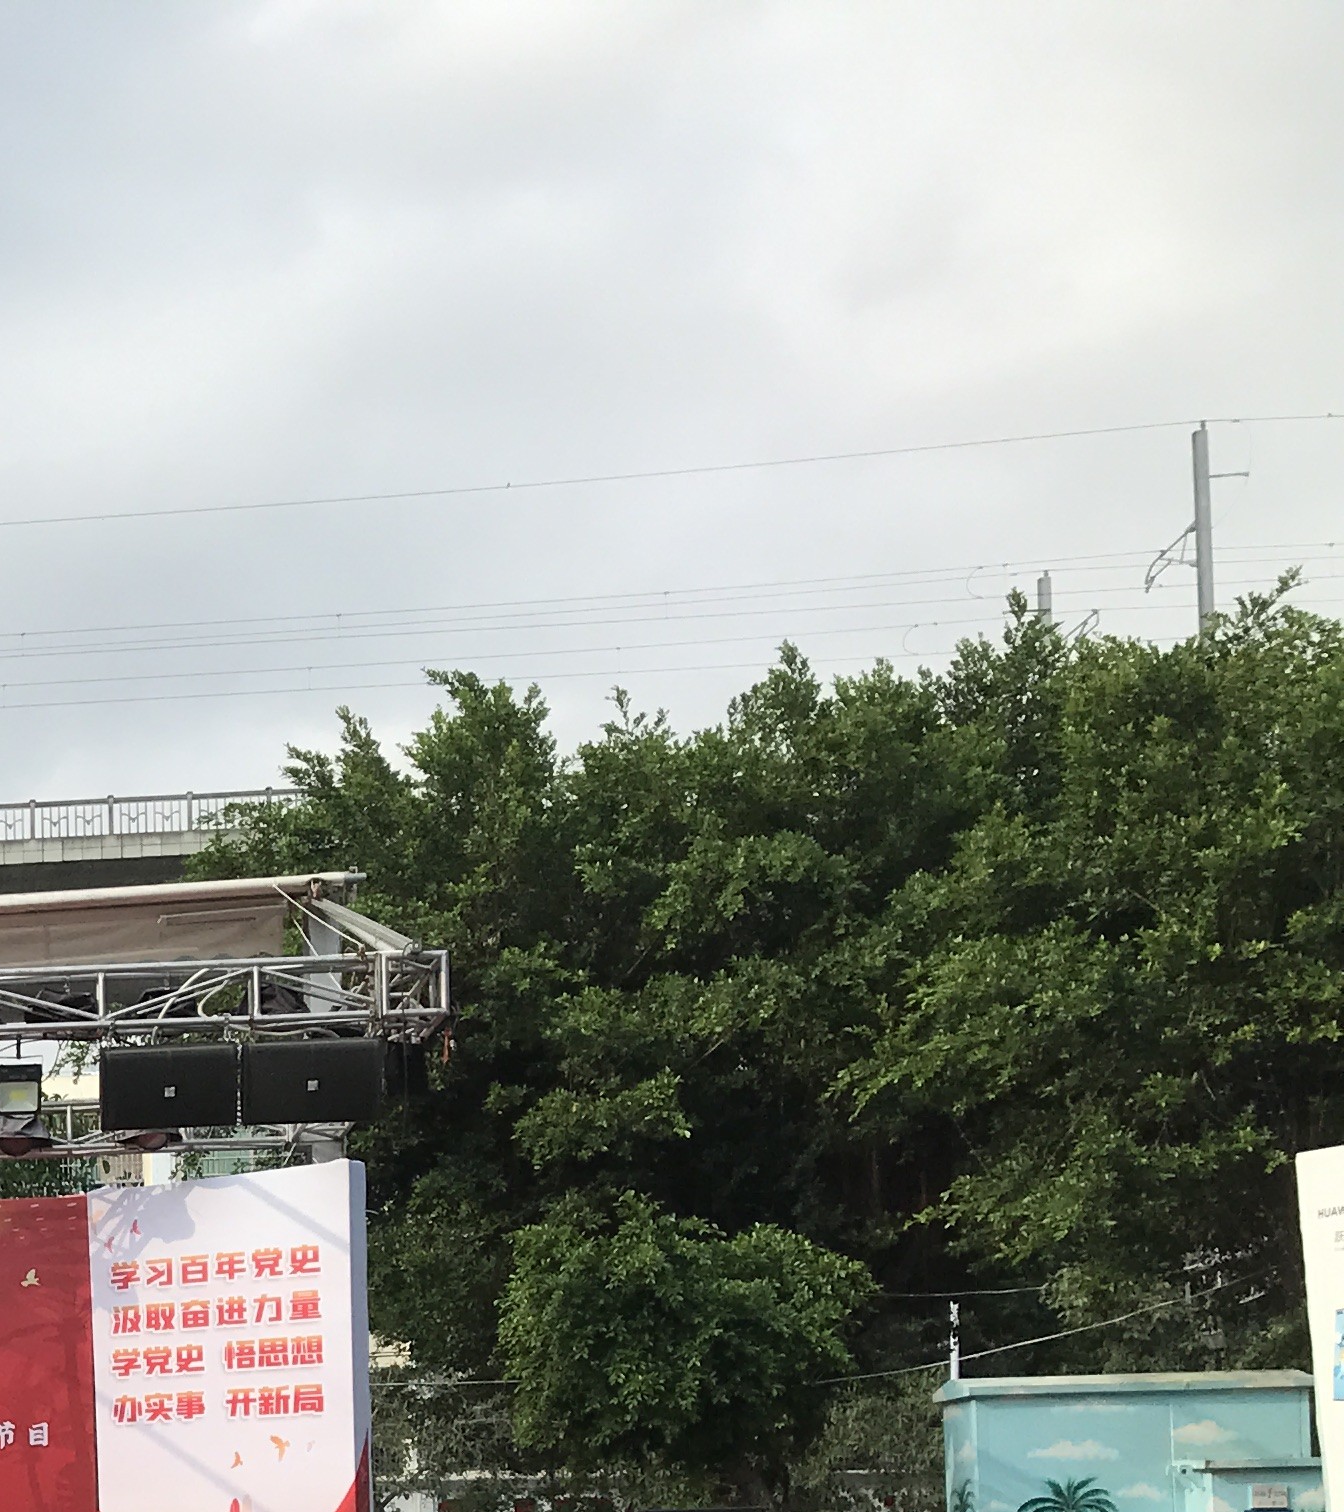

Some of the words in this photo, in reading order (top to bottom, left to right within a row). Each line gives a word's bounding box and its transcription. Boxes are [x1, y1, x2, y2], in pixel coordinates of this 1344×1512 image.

[110, 1244, 321, 1290] 学习百年党史
[112, 1289, 322, 1334] 汲取奋进力量
[112, 1344, 205, 1377] 学党史
[224, 1335, 324, 1370] 悟思想
[113, 1391, 205, 1423] 办实事
[226, 1384, 324, 1417] 开新局
